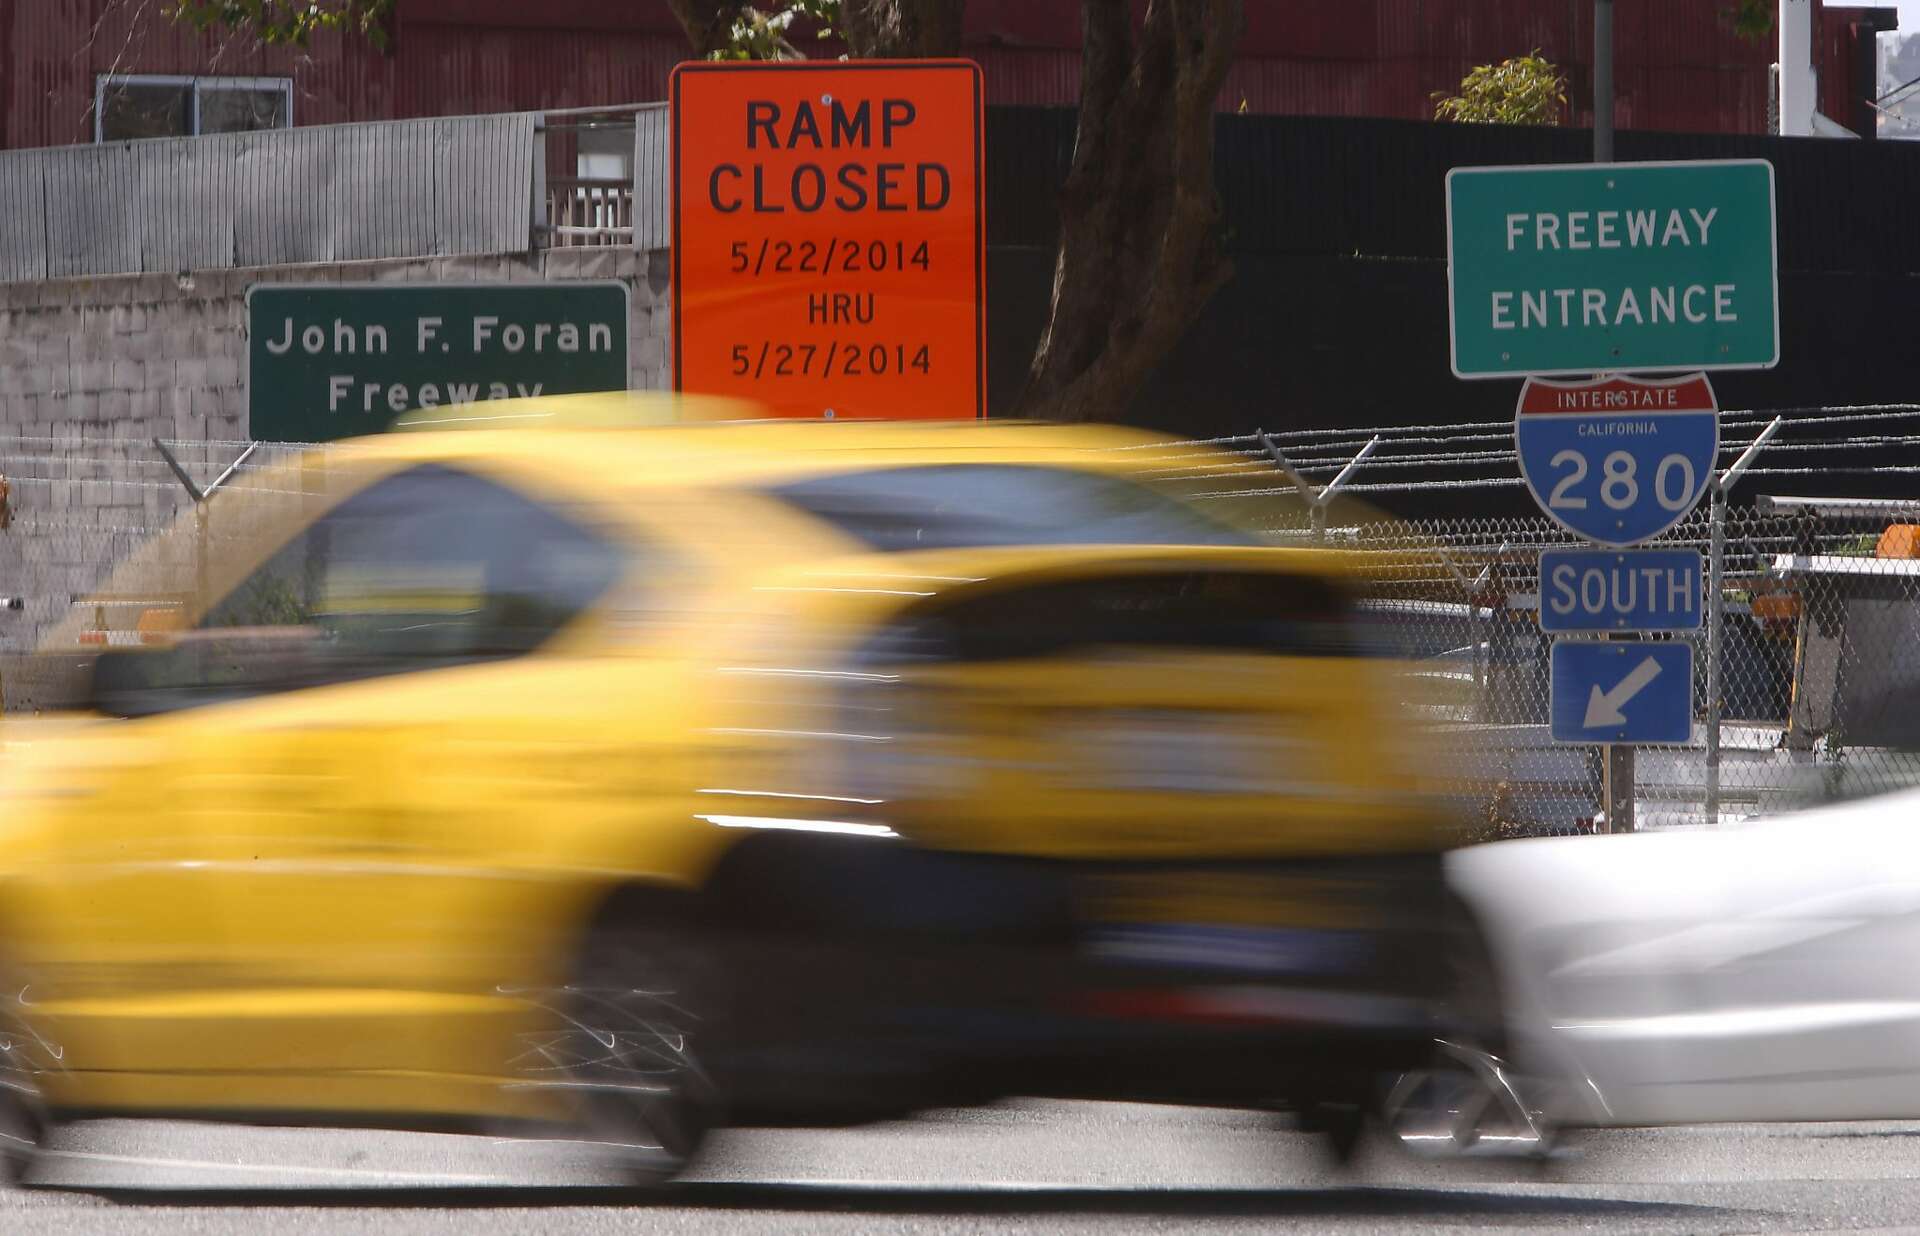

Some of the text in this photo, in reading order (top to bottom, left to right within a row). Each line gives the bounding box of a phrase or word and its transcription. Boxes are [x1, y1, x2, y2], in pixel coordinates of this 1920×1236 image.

[746, 98, 917, 149] RAMP
[708, 162, 951, 212] CLOSED
[1506, 207, 1718, 250] FREEWAY
[730, 237, 930, 275] 5/22/2014
[808, 292, 875, 325] HRU
[1491, 284, 1738, 329] ENTRANCE
[265, 315, 613, 354] John F. Foran
[731, 341, 931, 378] 5/27/2014
[1557, 389, 1678, 409] INTERSTATE
[1577, 421, 1659, 437] CALIFORNIA
[1549, 449, 1695, 512] 280
[1550, 564, 1693, 614] SOUTH
